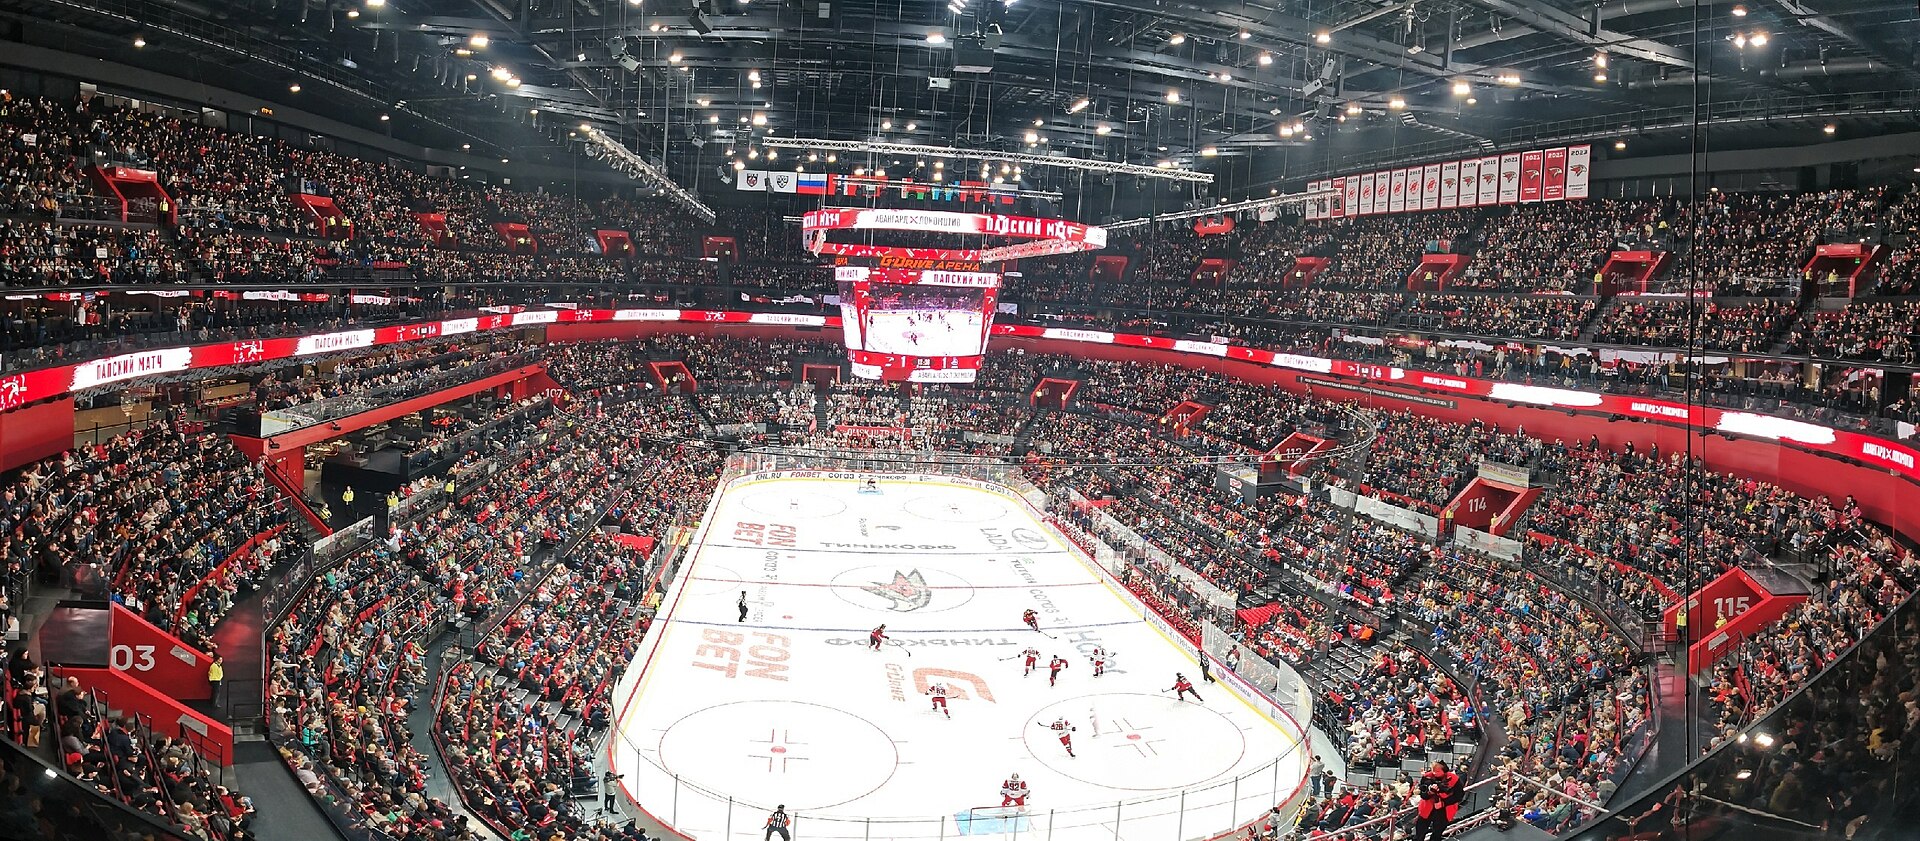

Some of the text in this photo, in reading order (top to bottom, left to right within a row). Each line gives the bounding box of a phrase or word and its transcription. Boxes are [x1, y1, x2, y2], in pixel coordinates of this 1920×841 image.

[936, 262, 980, 271] АРЕНА
[934, 273, 973, 284] ПАПСКИЙ
[315, 334, 359, 350] ПАПСКИЙ МАТЧ
[97, 354, 162, 380] ПАПСКИЙ МАТЧ
[545, 388, 563, 398] 107
[756, 472, 782, 481] KHL.RU
[1468, 497, 1487, 512] 114
[733, 521, 765, 546] BET
[767, 523, 796, 547] FON
[1714, 597, 1750, 616] 115
[692, 628, 744, 679] BET
[744, 631, 791, 682] FON
[1009, 783, 1020, 791] 92
